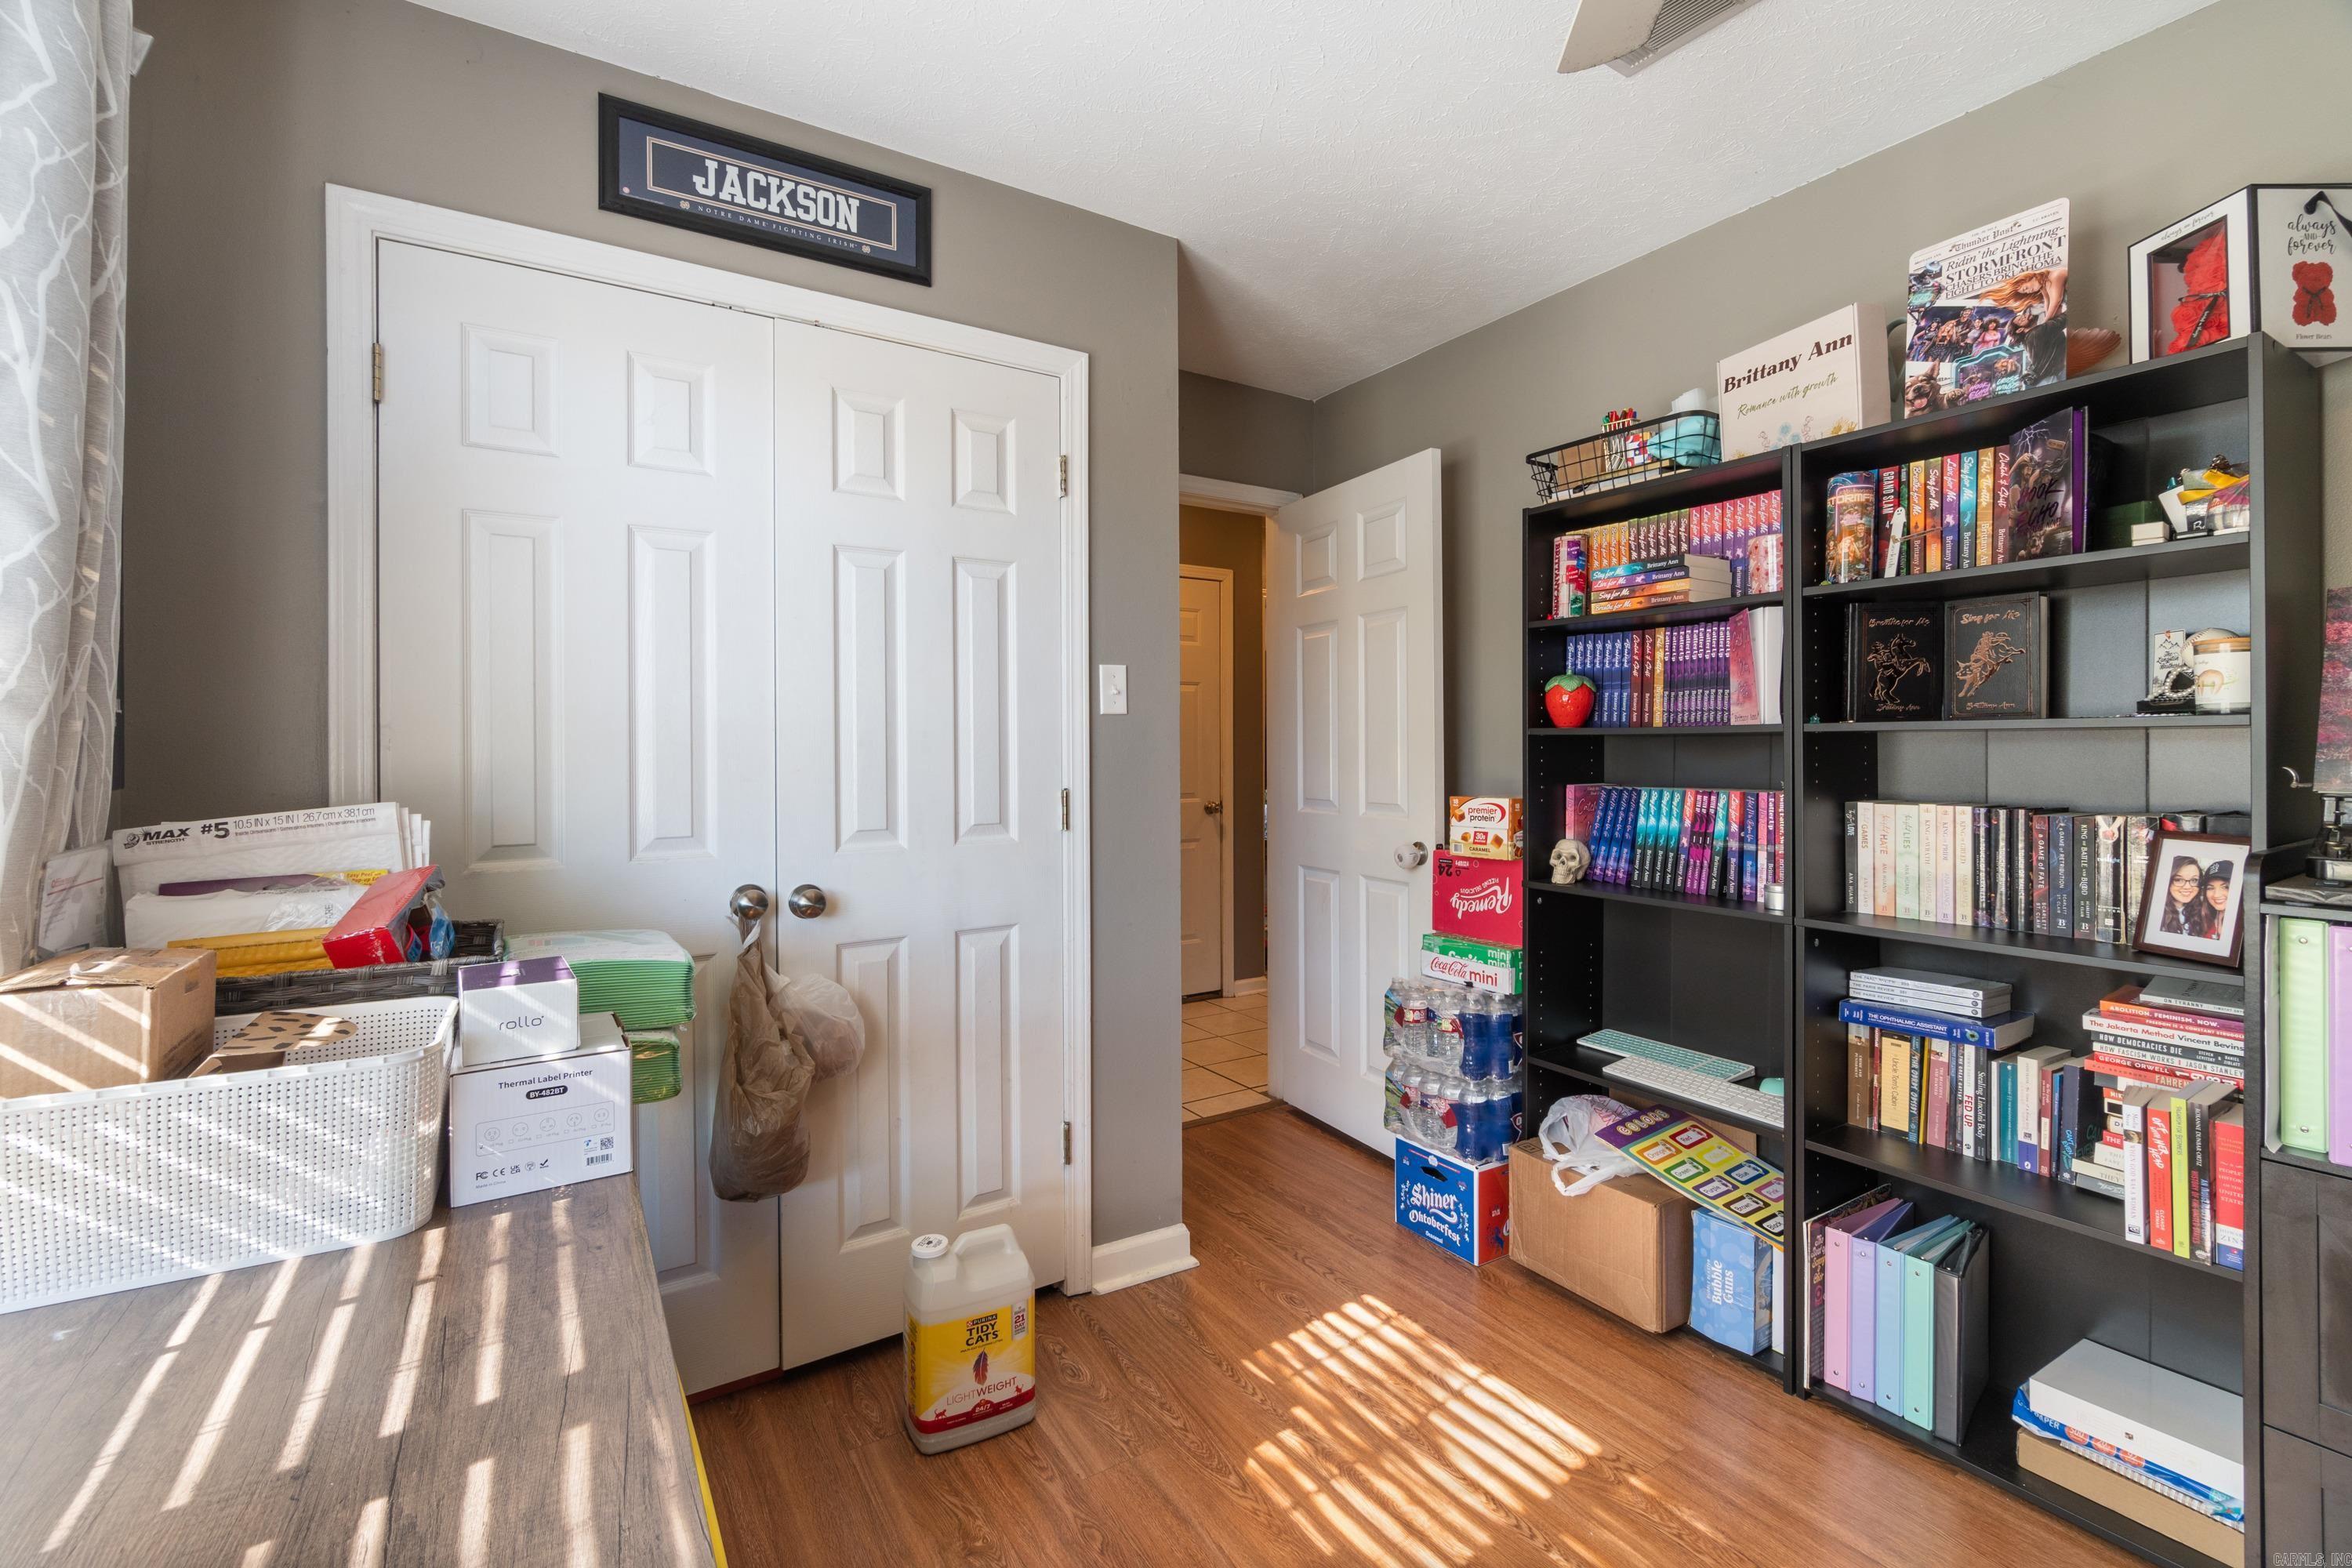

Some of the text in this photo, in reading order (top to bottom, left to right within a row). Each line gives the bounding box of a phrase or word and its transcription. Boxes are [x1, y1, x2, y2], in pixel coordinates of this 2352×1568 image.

[692, 158, 860, 234] JACKSON
[698, 205, 855, 248] NOTRE DAME FIGHTING IRISH
[2288, 214, 2336, 238] always
[1955, 234, 1990, 252] Thunder
[1981, 247, 1998, 260] the
[2001, 226, 2065, 253] Lightning-
[2288, 238, 2336, 256] forever
[1946, 234, 2066, 285] STORMFRONT
[1945, 250, 2054, 292] CHASERS BRING THE
[1945, 256, 2063, 299] FIGHT TO OKLAHOMA
[1723, 334, 1853, 394] Brittany Ann
[1737, 372, 1838, 419] Romance with growth
[1944, 458, 1957, 503] Live for Me
[1961, 456, 1974, 502] Stay for Me
[1882, 471, 1895, 514] GRAND SLAM
[1962, 532, 1971, 558] Brittany
[1980, 523, 1989, 554] Brittany
[1997, 528, 2005, 554] Brittany
[1944, 535, 1953, 561] Brittany
[1599, 591, 1610, 600] Sing
[1960, 609, 2020, 625] Sing for Me
[201, 822, 230, 839] #5
[233, 818, 252, 830] 10.5
[254, 818, 263, 828] IN
[273, 816, 284, 826] 15
[285, 815, 295, 824] IN
[1768, 822, 1774, 830] Up
[143, 827, 191, 841] MAX
[1438, 863, 1453, 877] 24
[2038, 862, 2045, 870] of
[1450, 877, 1512, 920] Remedy
[1460, 885, 1482, 894] DELICIOUS
[1487, 949, 1511, 961] mini
[1469, 970, 1497, 987] mini
[2175, 999, 2204, 1008] TYRANNY
[499, 1017, 543, 1030] rollo
[1879, 1014, 1916, 1027] OPHTHALMIC
[1916, 1021, 1947, 1032] ASSISTANT
[2109, 1005, 2152, 1017] ABOLITION.
[2154, 1012, 2195, 1024] FEMINISM.
[2089, 1019, 2245, 1051] The Jakarta Method Vincent Bevins
[2185, 1025, 2216, 1034] CONSTANT
[2099, 1033, 2183, 1055] HOW DEMOCRACIES DIE
[2099, 1055, 2132, 1066] GEORGE
[2134, 1062, 2169, 1074] ORWELL
[2118, 1047, 2147, 1059] FASCISM
[2150, 1054, 2175, 1065] WORKS
[2185, 1058, 2208, 1071] JASON
[2211, 1065, 2244, 1077] STANLEY
[499, 1069, 593, 1090] Thermal Label Printer
[529, 1086, 564, 1098] BY-482BT
[1891, 1091, 1900, 1107] Cabin
[1964, 1094, 1973, 1127] FED UP.
[1976, 1071, 1986, 1139] Stealing Lincoln's Body
[1617, 1109, 1670, 1135] COLORS
[2151, 1117, 2168, 1134] OFF
[1679, 1134, 1692, 1143] Red
[2106, 1135, 2122, 1145] THE
[2152, 1138, 2169, 1156] HER
[1646, 1147, 1669, 1160] Orange
[2148, 1147, 2165, 1169] HEAD
[492, 1167, 506, 1178] CE
[1675, 1166, 1693, 1178] Green
[1735, 1170, 1750, 1179] Blue
[1410, 1182, 1459, 1211] Shiner
[1702, 1184, 1722, 1196] Purple
[1766, 1186, 1780, 1196] Pink
[1734, 1201, 1753, 1213] Brown
[1409, 1209, 1461, 1247] Oktoberfest
[1766, 1220, 1782, 1231] Black
[1711, 1260, 1722, 1305] Bubble
[1723, 1269, 1734, 1304] Guns
[973, 1314, 996, 1325] PURINA
[1014, 1313, 1025, 1324] 21
[966, 1321, 997, 1337] TIDY
[965, 1330, 1000, 1347] CATS
[946, 1376, 1017, 1406] LIGHTWEIGHT
[975, 1403, 991, 1413] 24/7
